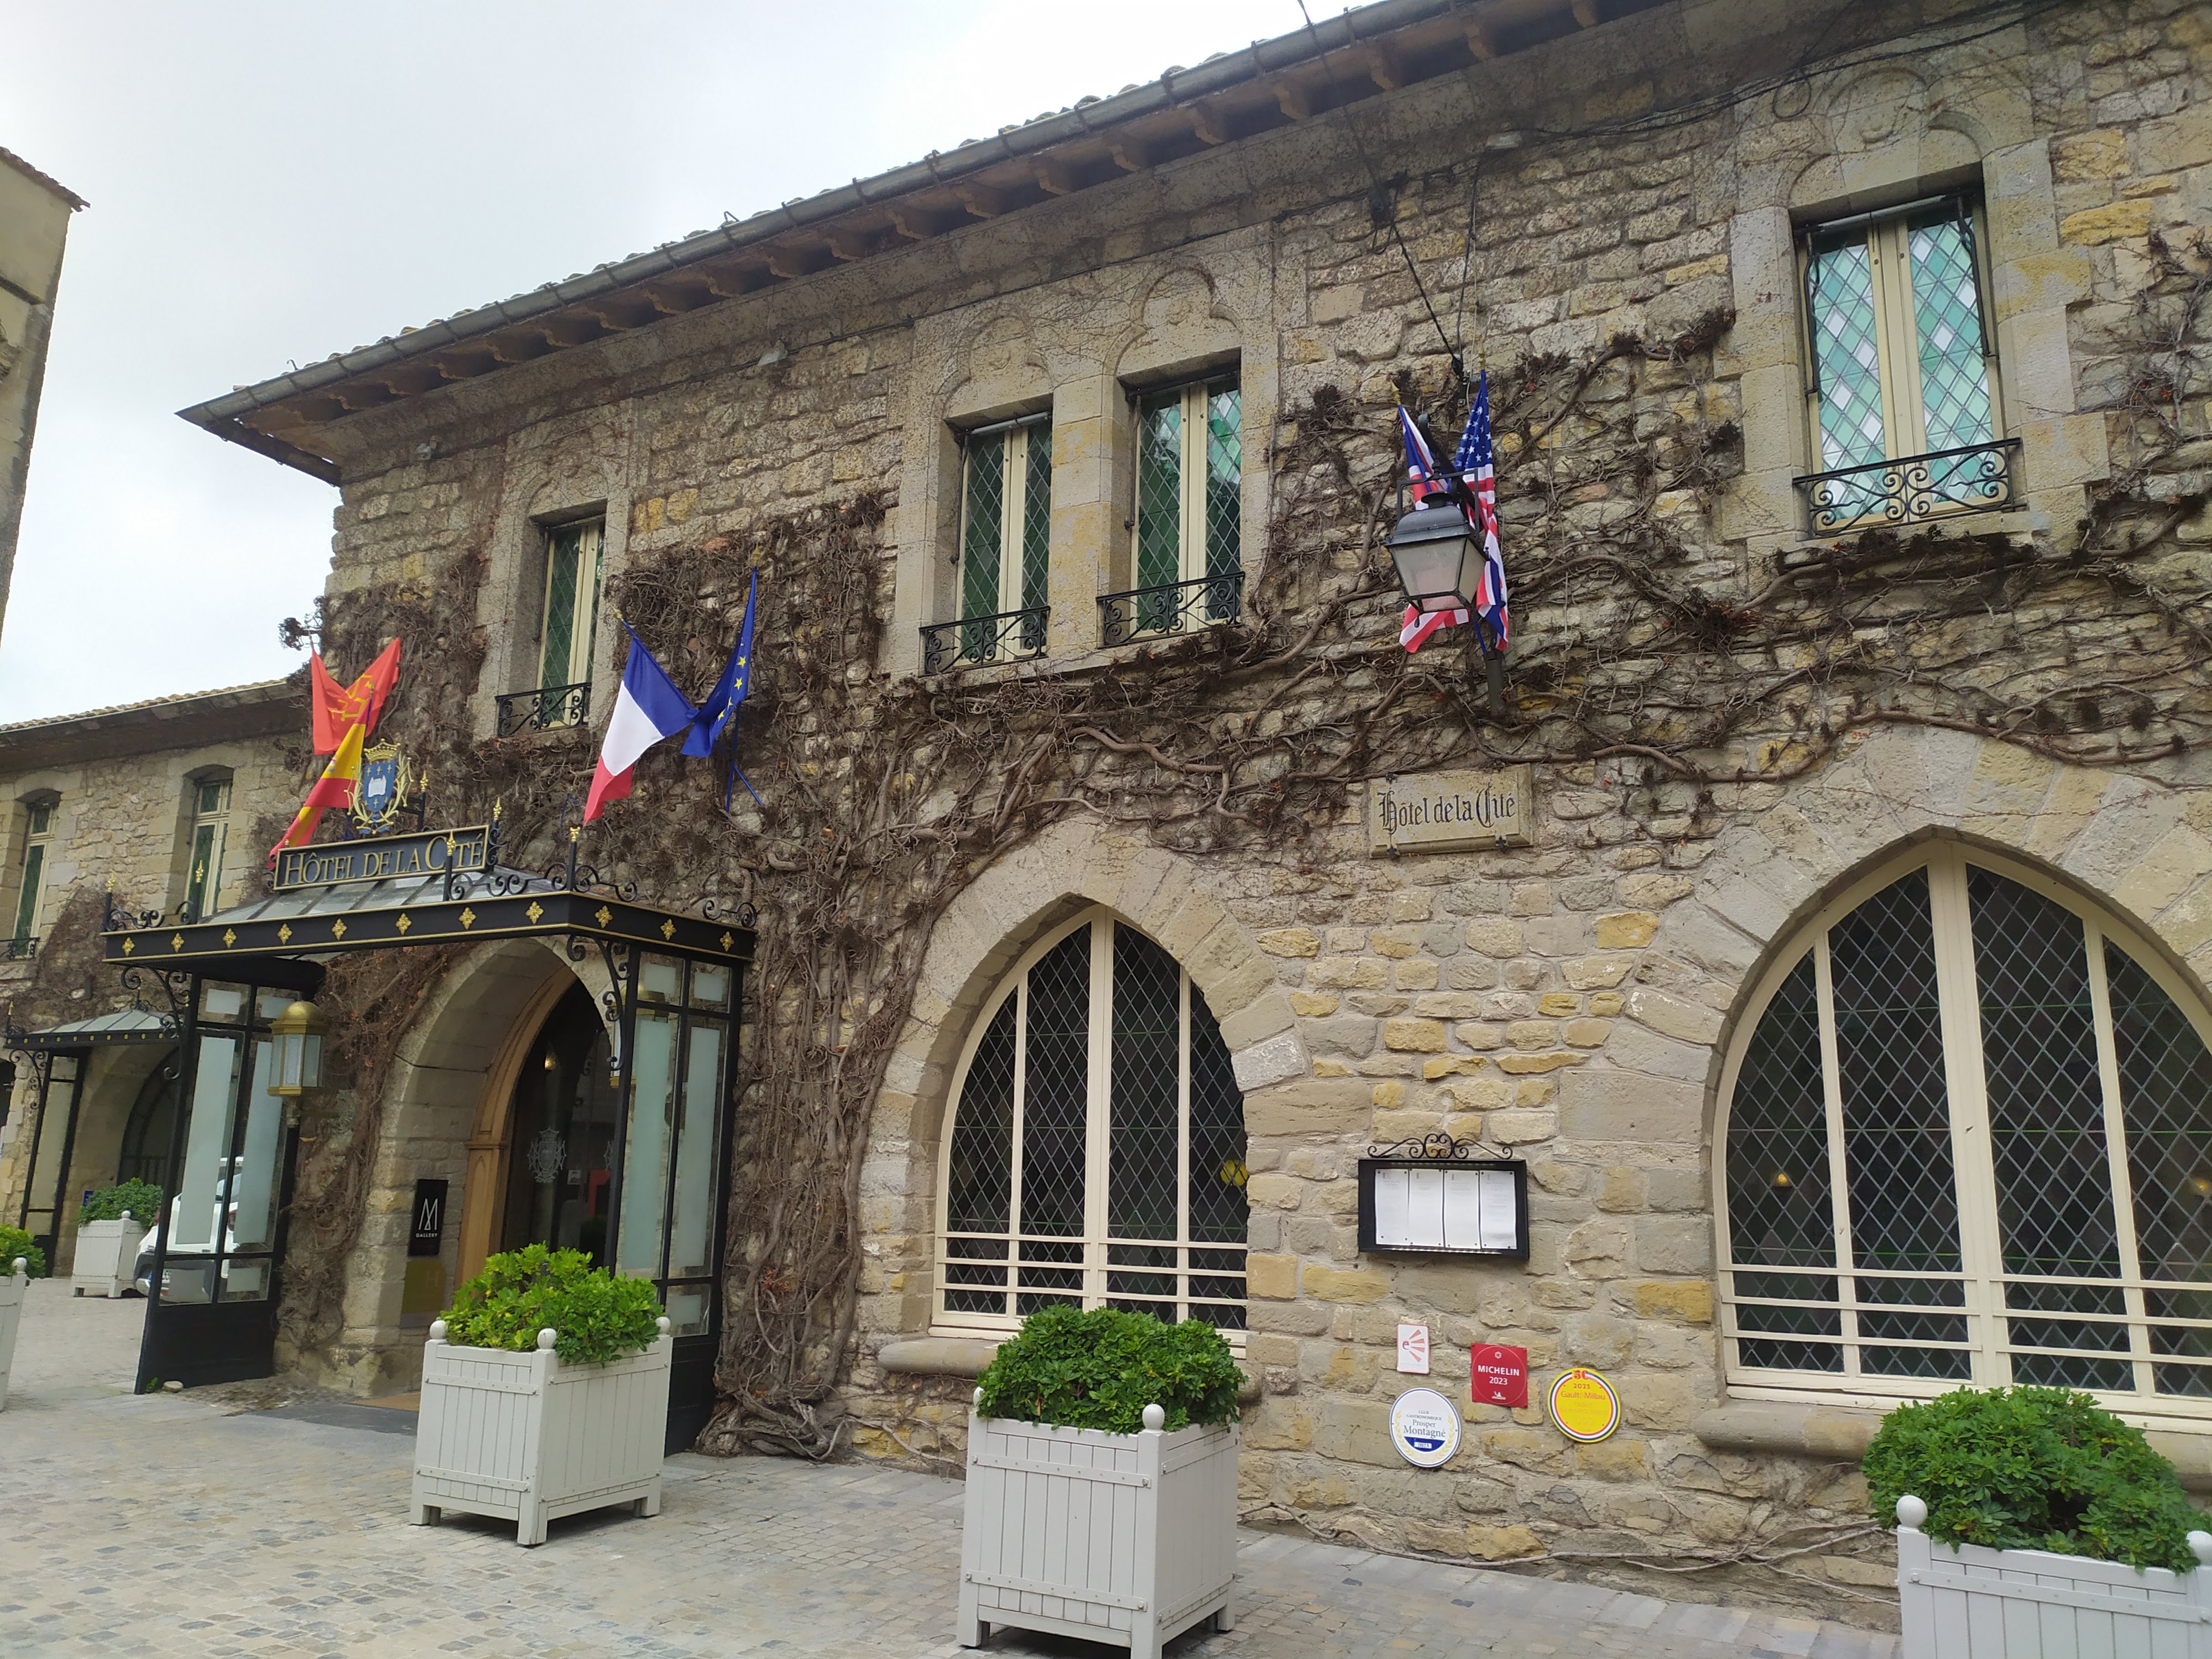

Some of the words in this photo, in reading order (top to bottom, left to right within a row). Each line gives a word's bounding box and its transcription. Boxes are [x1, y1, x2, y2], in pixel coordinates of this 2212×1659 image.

[1433, 796, 1453, 823] de
[1454, 794, 1474, 822] la
[1476, 782, 1516, 828] Cité
[281, 852, 356, 886] HÔTEL
[361, 852, 391, 877] DE
[394, 848, 422, 874] LA
[425, 833, 483, 870] CTÉ
[1477, 1365, 1520, 1376] MICHELIN
[1489, 1376, 1507, 1385] 2023
[1412, 1419, 1436, 1428] Prosper
[1403, 1425, 1446, 1439] Montagné
